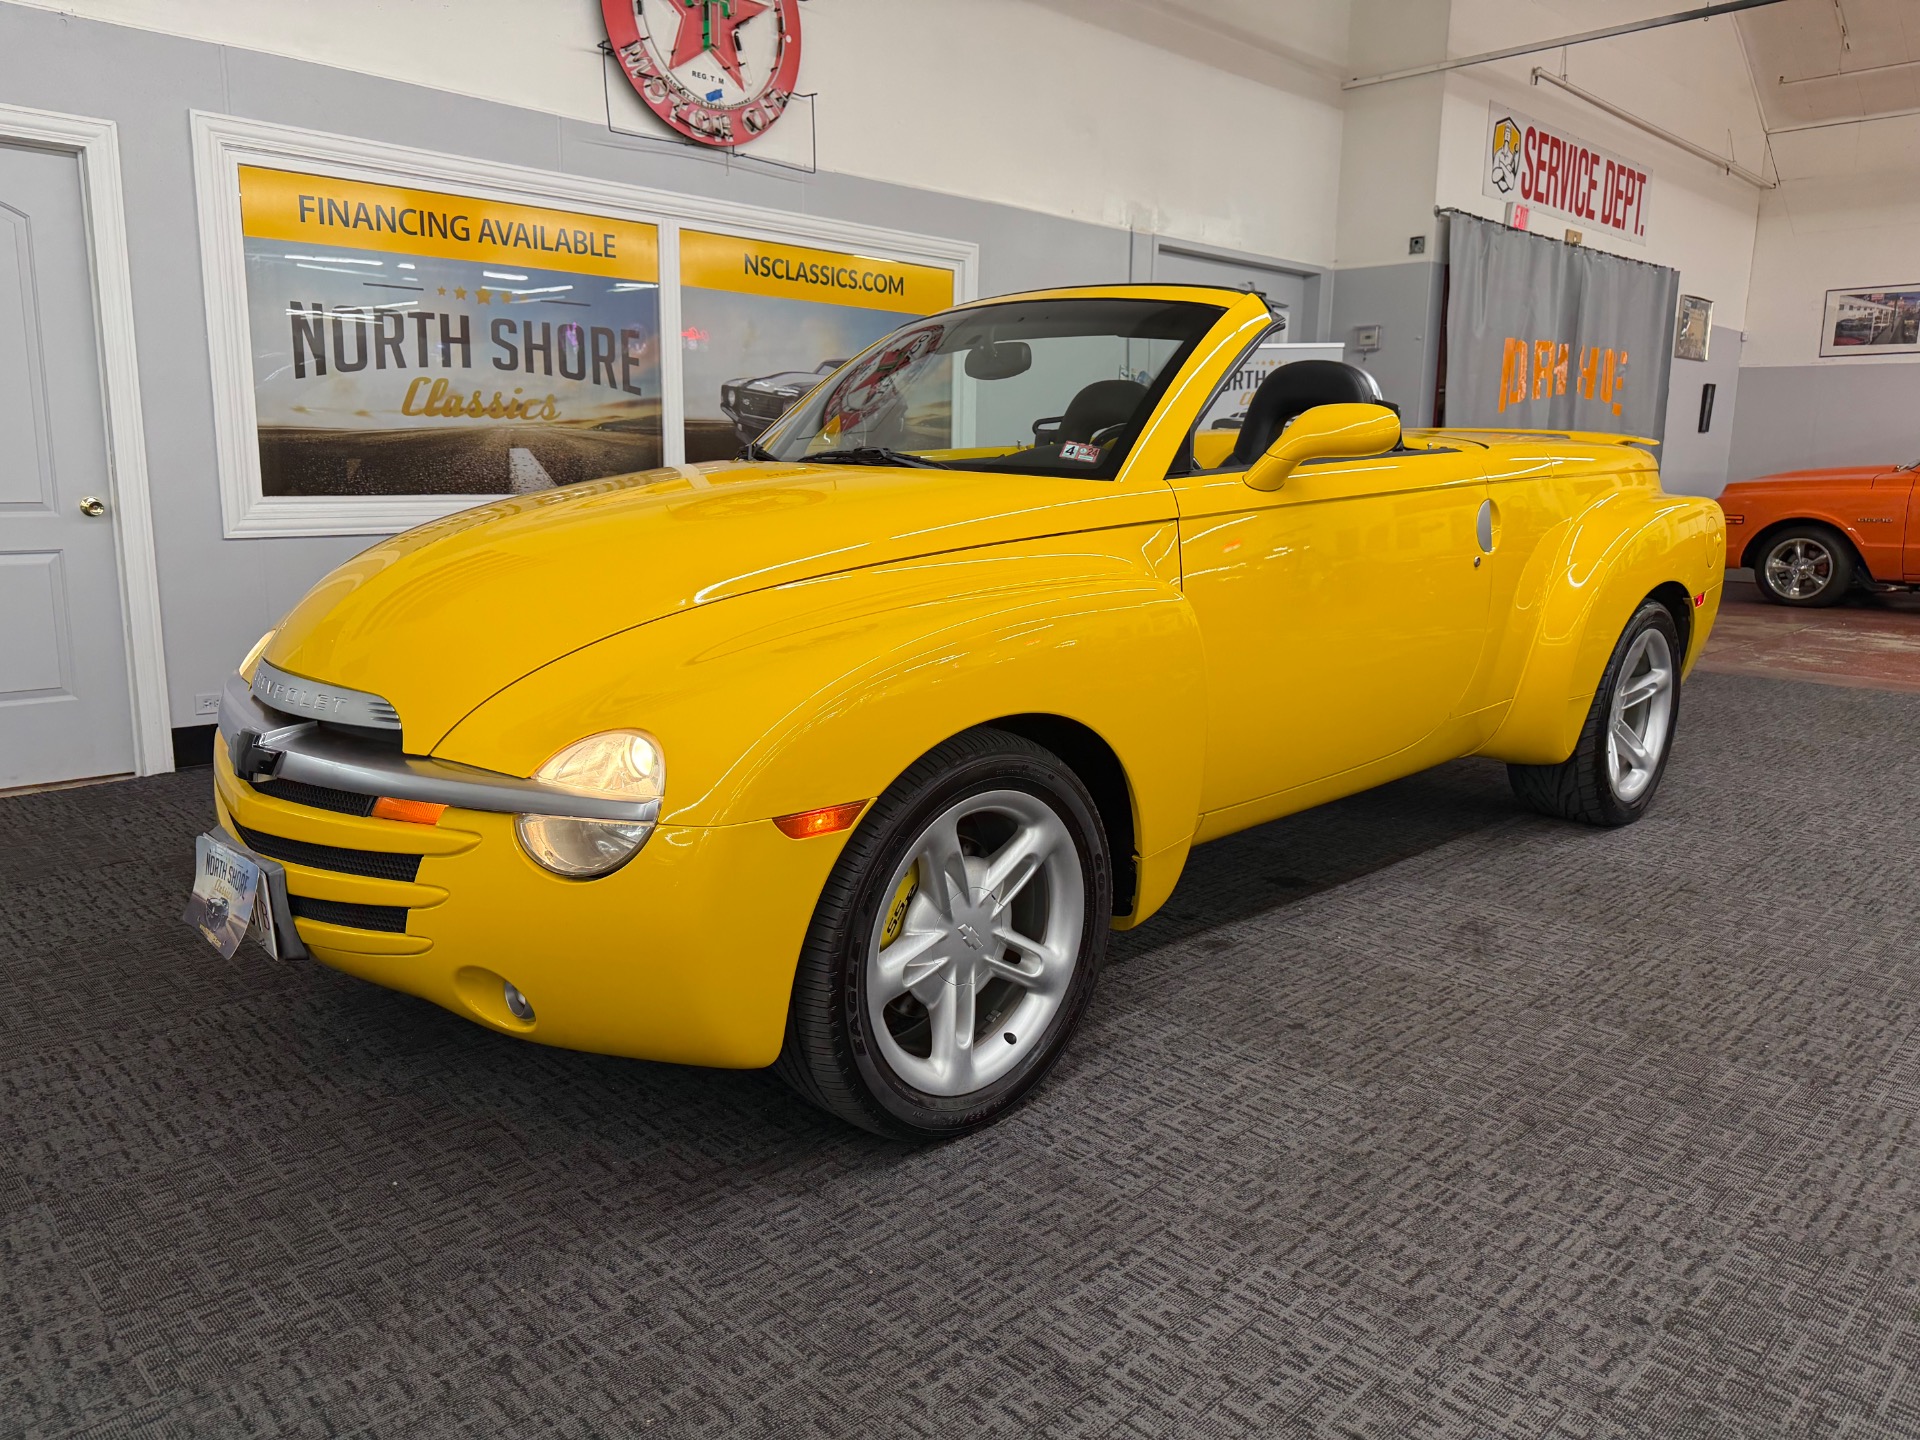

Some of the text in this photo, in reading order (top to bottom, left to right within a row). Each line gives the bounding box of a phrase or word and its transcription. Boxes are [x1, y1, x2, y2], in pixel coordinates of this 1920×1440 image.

[1521, 126, 1647, 237] SERVICE DEPT.
[298, 194, 617, 259] FINANCING AVAILABLE
[744, 253, 904, 296] NSCLASSICS.COM
[290, 301, 642, 396] NORTH SHORE
[401, 376, 561, 421] Classics
[1065, 445, 1076, 456] 4
[206, 850, 228, 879] NORTH
